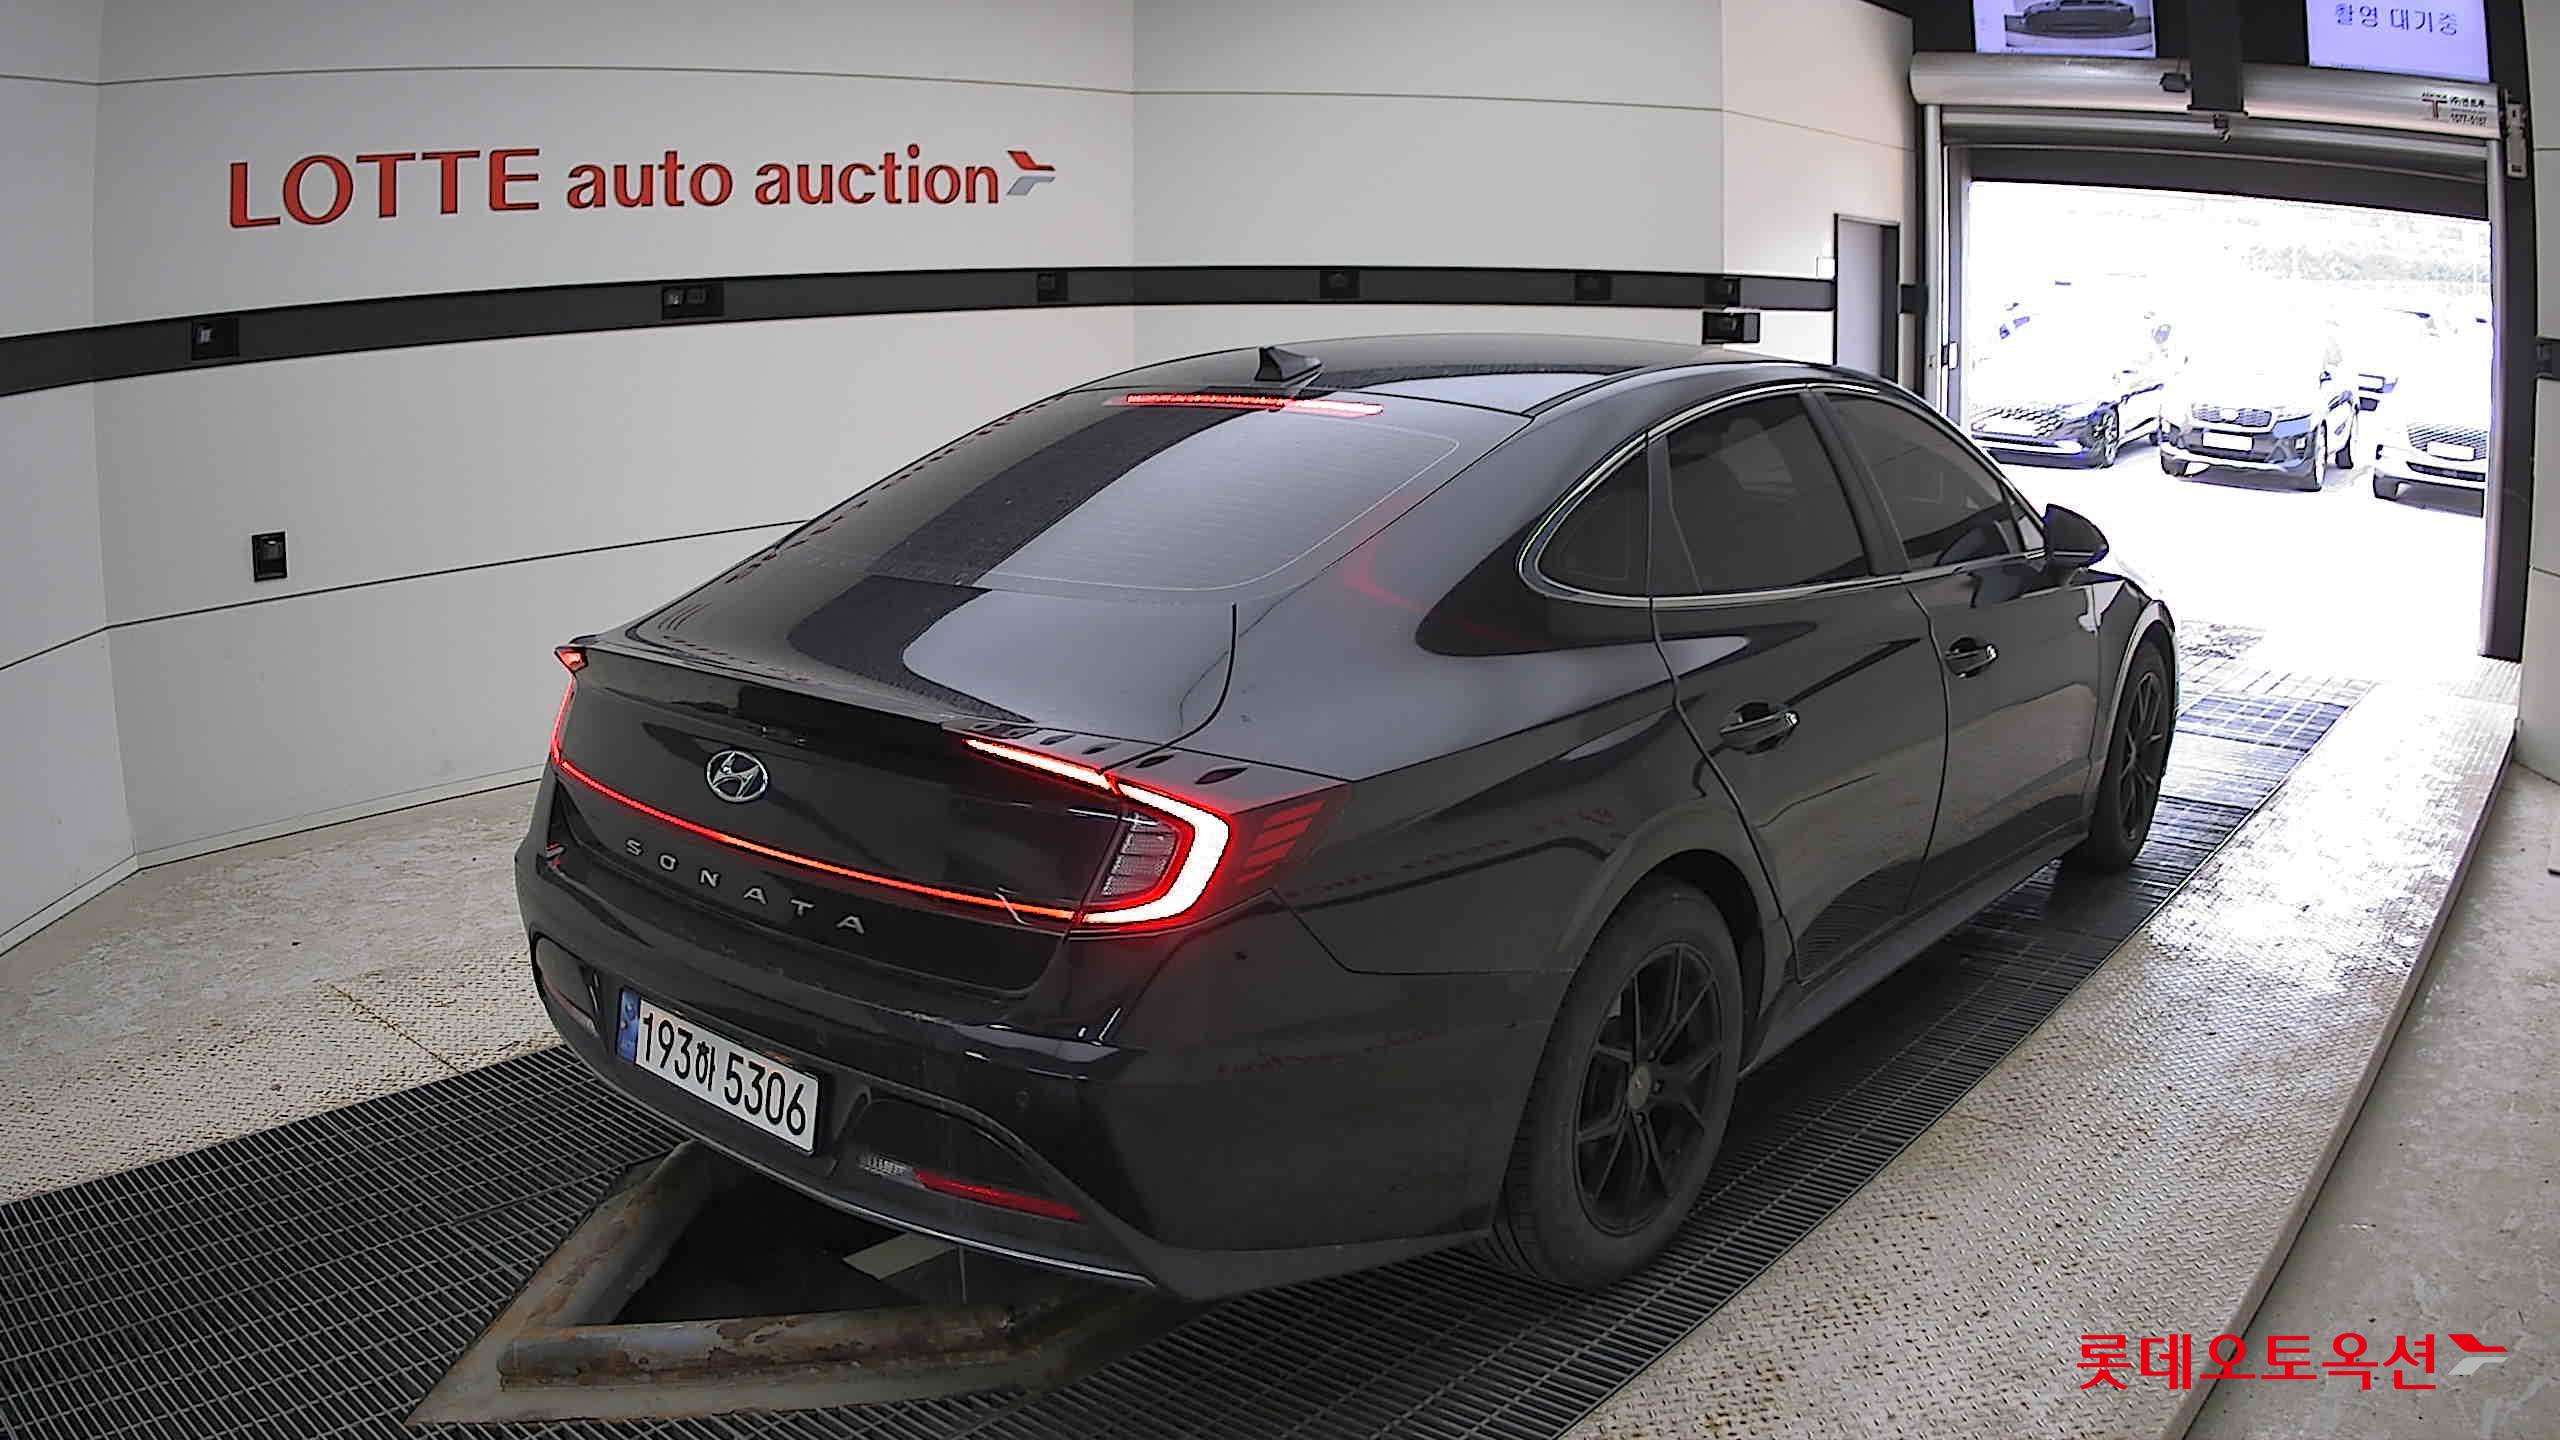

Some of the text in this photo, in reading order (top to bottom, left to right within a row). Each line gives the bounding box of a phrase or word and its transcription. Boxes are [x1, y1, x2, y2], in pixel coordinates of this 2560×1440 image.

[2390, 8, 2457, 36] 대기중
[229, 144, 1000, 229] LOTTE auto auction
[626, 838, 865, 935] SONATA
[643, 1012, 806, 1136] 193하 5306
